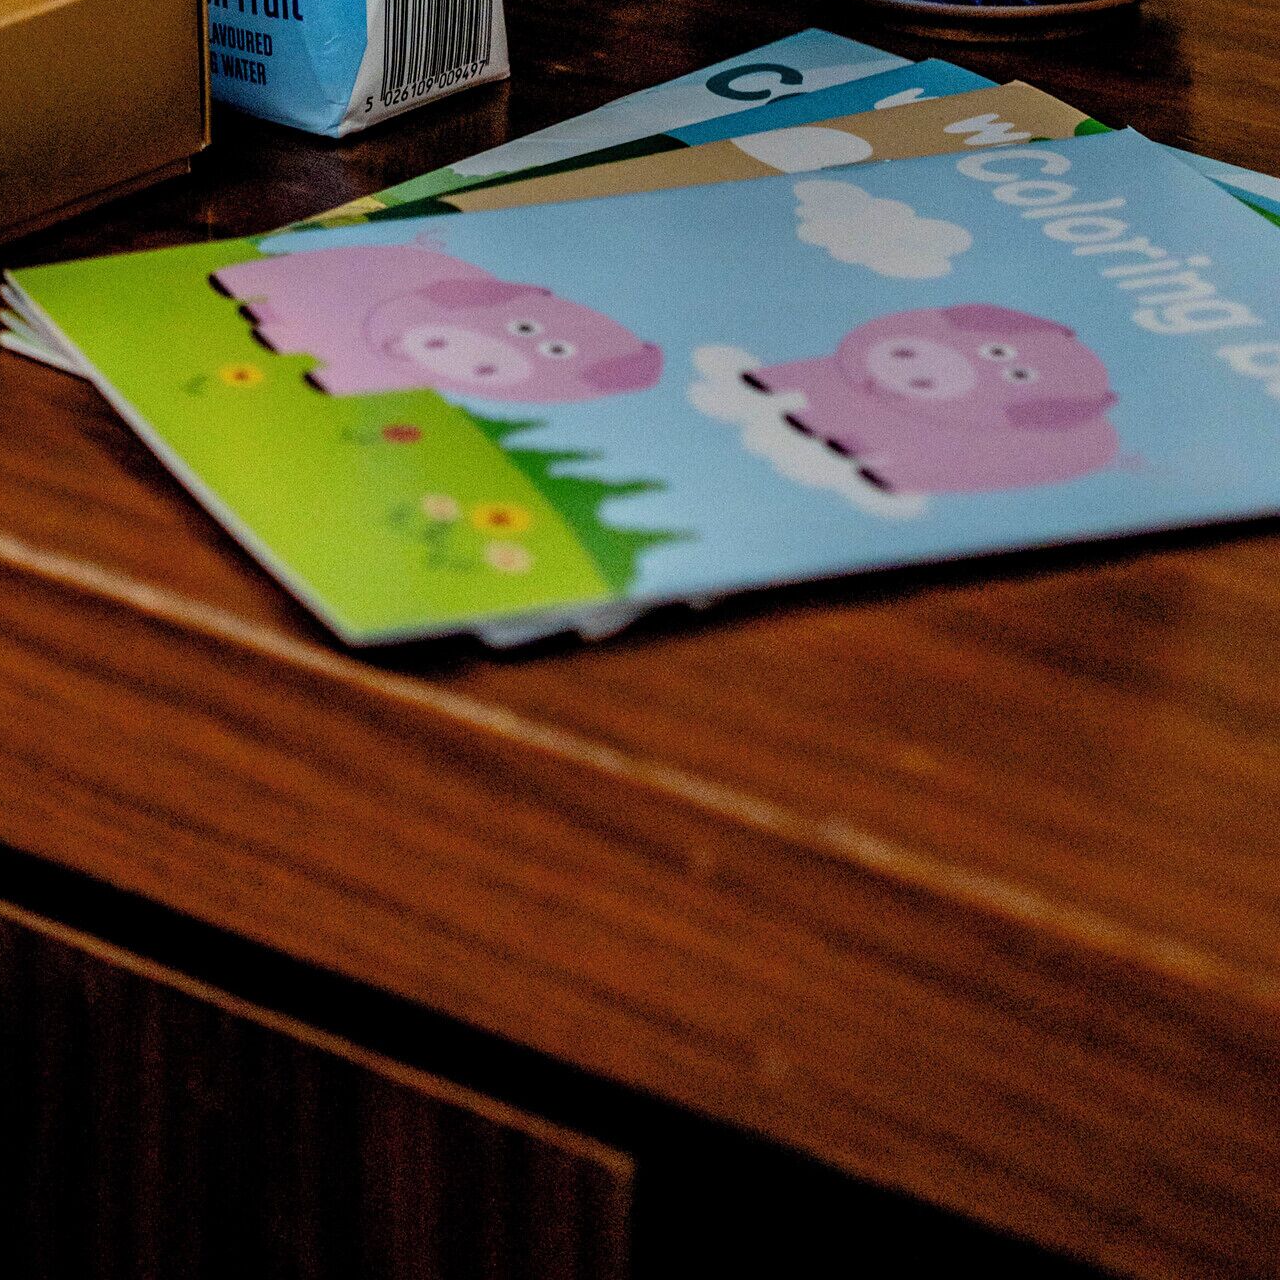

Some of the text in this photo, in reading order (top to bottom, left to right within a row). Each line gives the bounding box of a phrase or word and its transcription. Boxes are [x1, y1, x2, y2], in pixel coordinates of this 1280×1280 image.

[208, 21, 273, 57] AVOURED
[221, 53, 267, 86] WATER
[365, 60, 487, 113] 5 026109 009497
[956, 148, 1265, 335] Coloring
